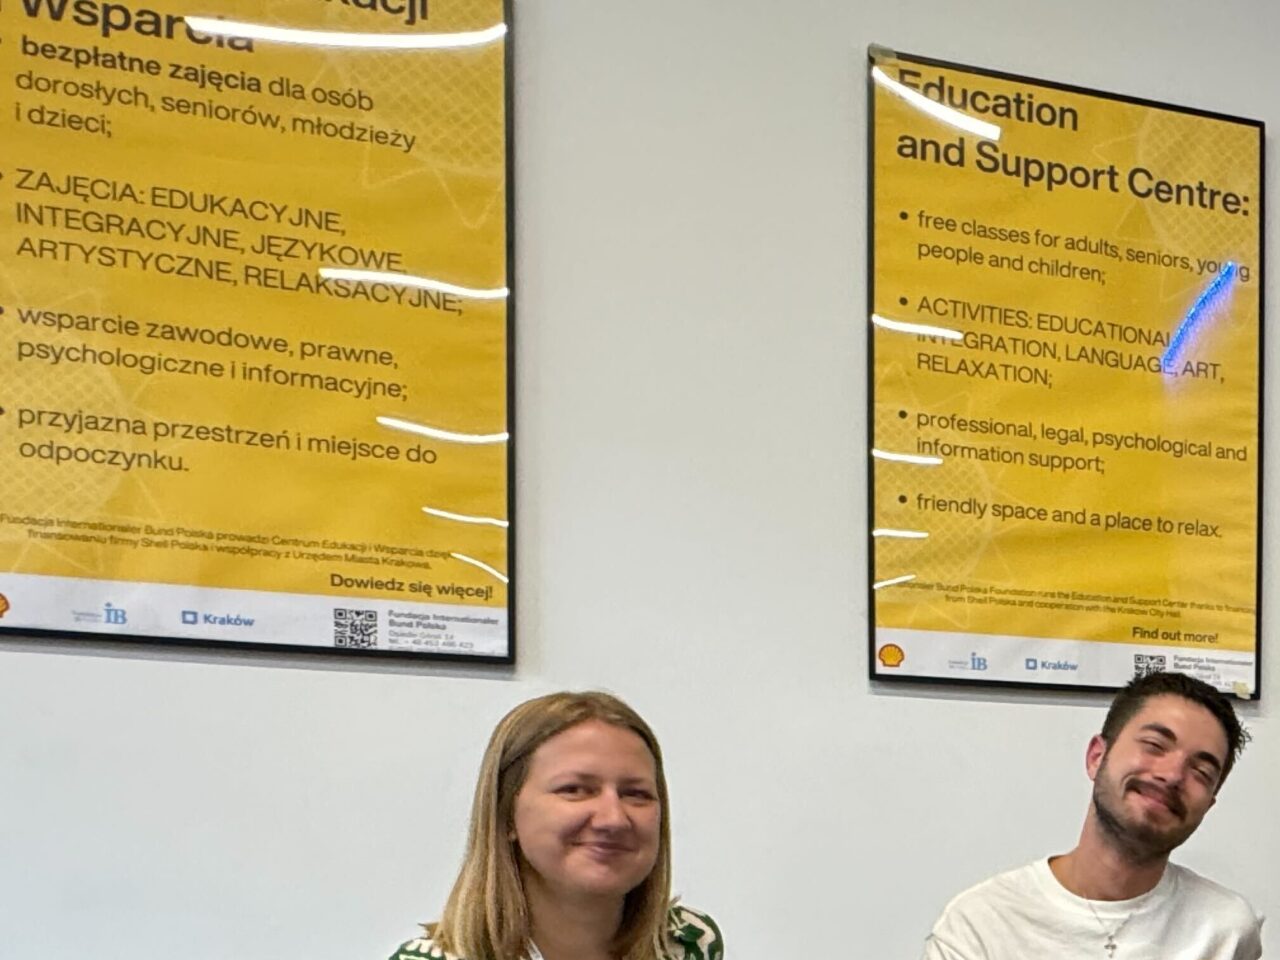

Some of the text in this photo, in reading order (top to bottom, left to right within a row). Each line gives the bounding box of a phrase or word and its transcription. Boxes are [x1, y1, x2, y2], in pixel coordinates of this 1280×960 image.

[20, 35, 373, 112] bezpłatne zajęcia dla osób
[15, 70, 415, 153] dorosłych, seniorów, młodzieży
[15, 103, 112, 137] i dzieci;
[899, 69, 1078, 131] Education
[897, 135, 1250, 216] and Support Centre:
[15, 169, 346, 236] ZAJĘCIA: EDUKACYJNE,
[15, 202, 245, 253] INTEGRACYJNE,
[917, 210, 1250, 282] free classes for adults, seniors, yog
[16, 238, 463, 316] ARTYSTYCZNE, RELAKSACYJNE;
[917, 242, 1105, 284] people and children;
[917, 296, 1032, 329] ACTIVITIES:
[17, 306, 398, 368] wsparcie zawodowe, prawne,
[17, 337, 408, 401] psychologiczne i informacyjne;
[917, 353, 1052, 387] RELAXATION;
[1182, 362, 1224, 383] ART,
[18, 406, 437, 465] przyjazna przestrzeń i miejsce do
[19, 440, 189, 473] odpoczynku.
[916, 411, 1247, 461] professional, legal, psychological and
[916, 438, 1104, 474] information support;
[916, 494, 1222, 538] friendly space and a place to relax.
[330, 573, 492, 600] Dowiedz się więcej!
[203, 614, 255, 626] Kraków
[1133, 627, 1218, 643] Find out more!
[1041, 660, 1078, 671] Kraków
